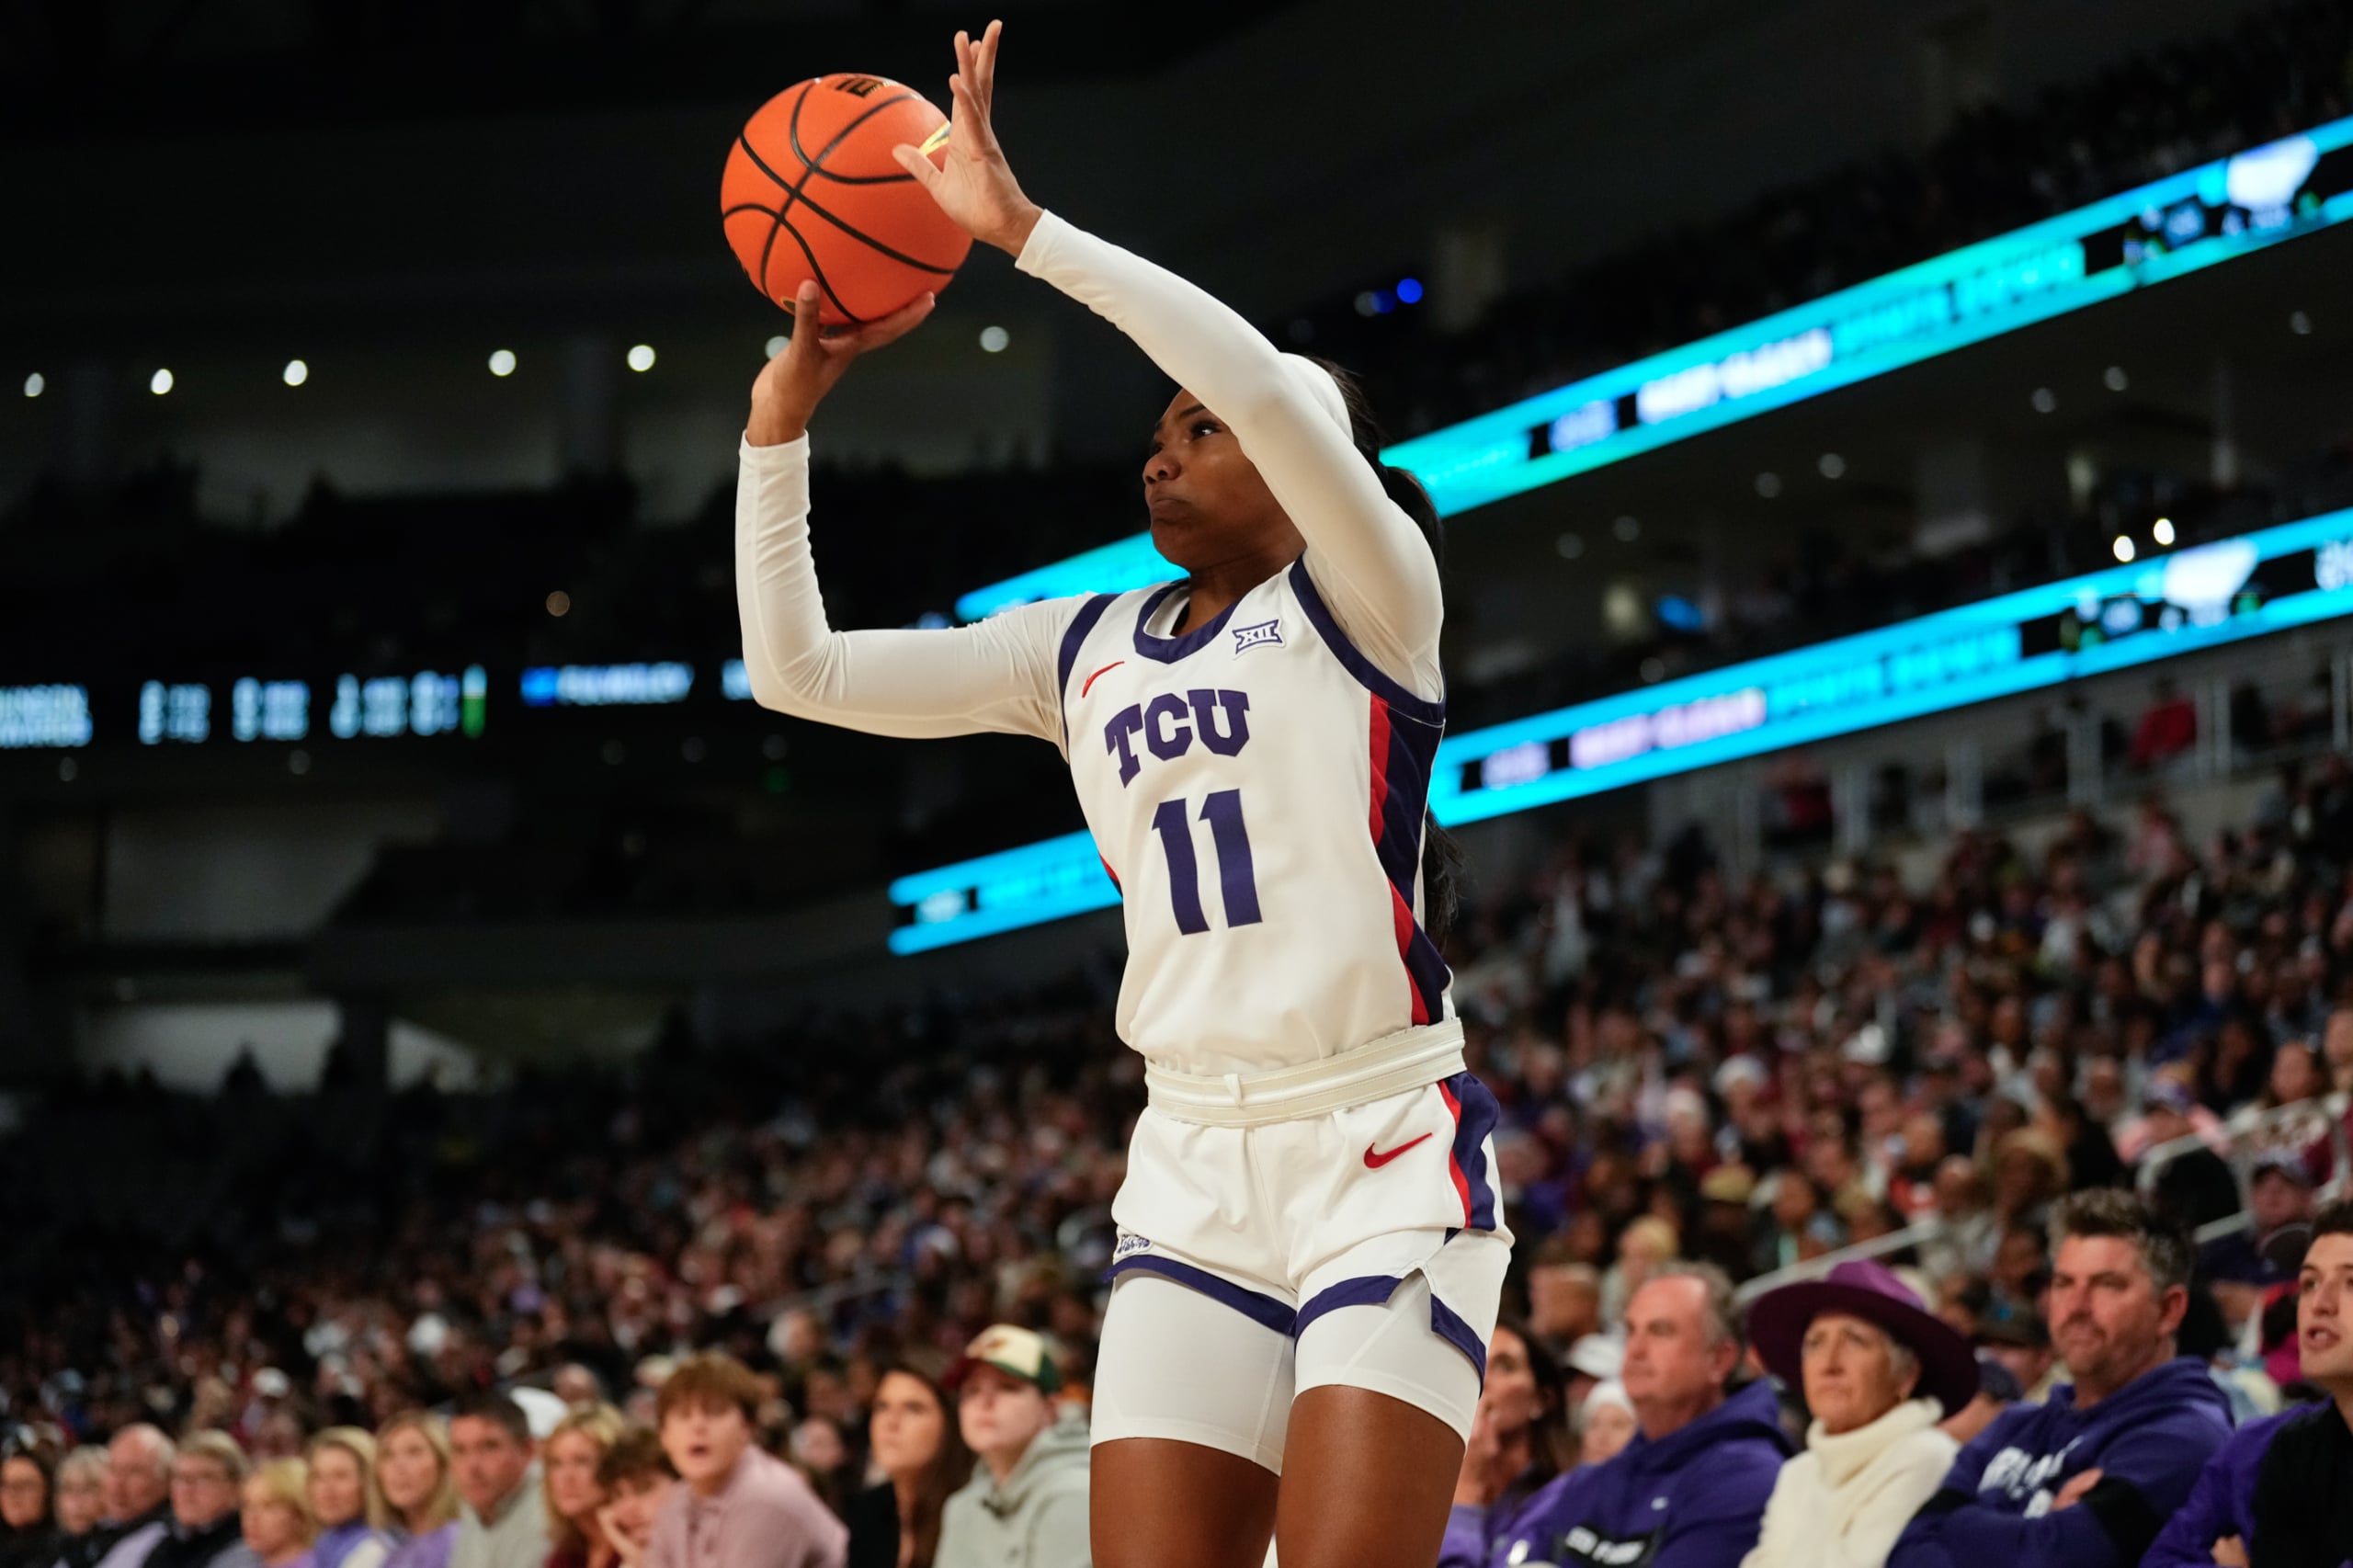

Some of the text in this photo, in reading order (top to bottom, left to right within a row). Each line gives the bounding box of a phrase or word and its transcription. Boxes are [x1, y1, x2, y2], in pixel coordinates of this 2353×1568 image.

[1233, 619, 1282, 653] XII
[1104, 689, 1250, 789] TCU
[1152, 789, 1263, 935] 11
